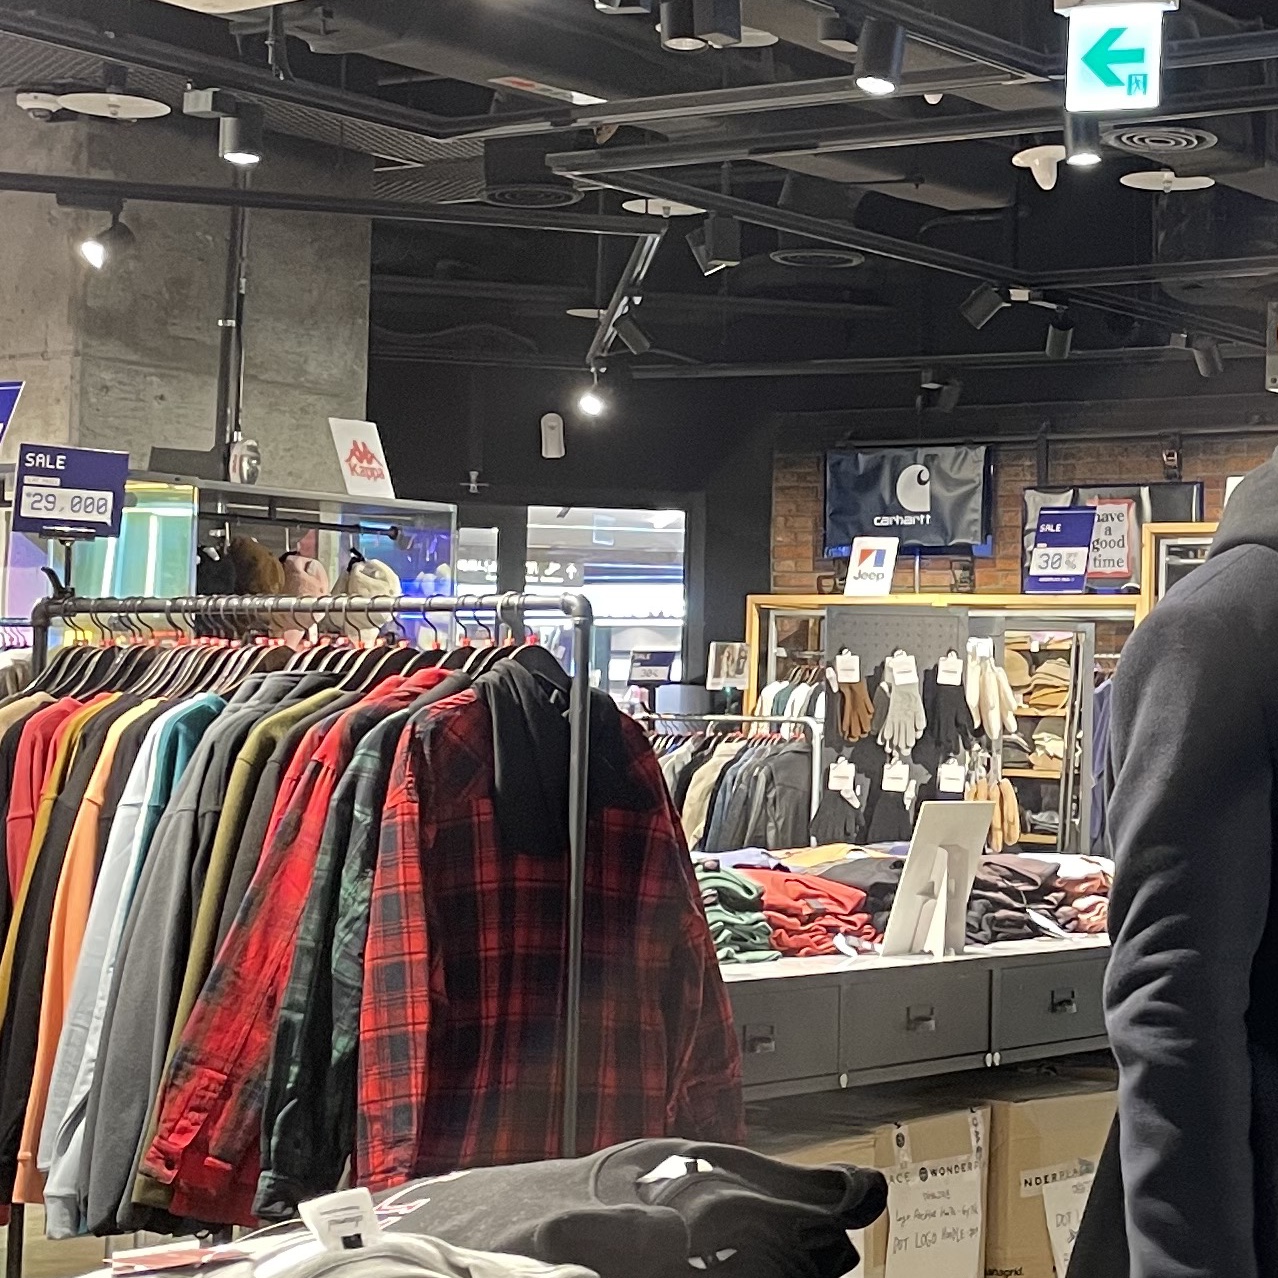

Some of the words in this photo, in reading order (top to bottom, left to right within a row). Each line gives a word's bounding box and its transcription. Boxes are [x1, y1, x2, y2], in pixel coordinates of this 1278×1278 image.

[25, 453, 67, 470] SALE
[873, 514, 932, 527] carhartt
[1039, 523, 1062, 533] SALE
[1104, 525, 1113, 536] a
[1092, 535, 1126, 552] good
[1093, 554, 1125, 568] time
[852, 569, 885, 582] Jeep
